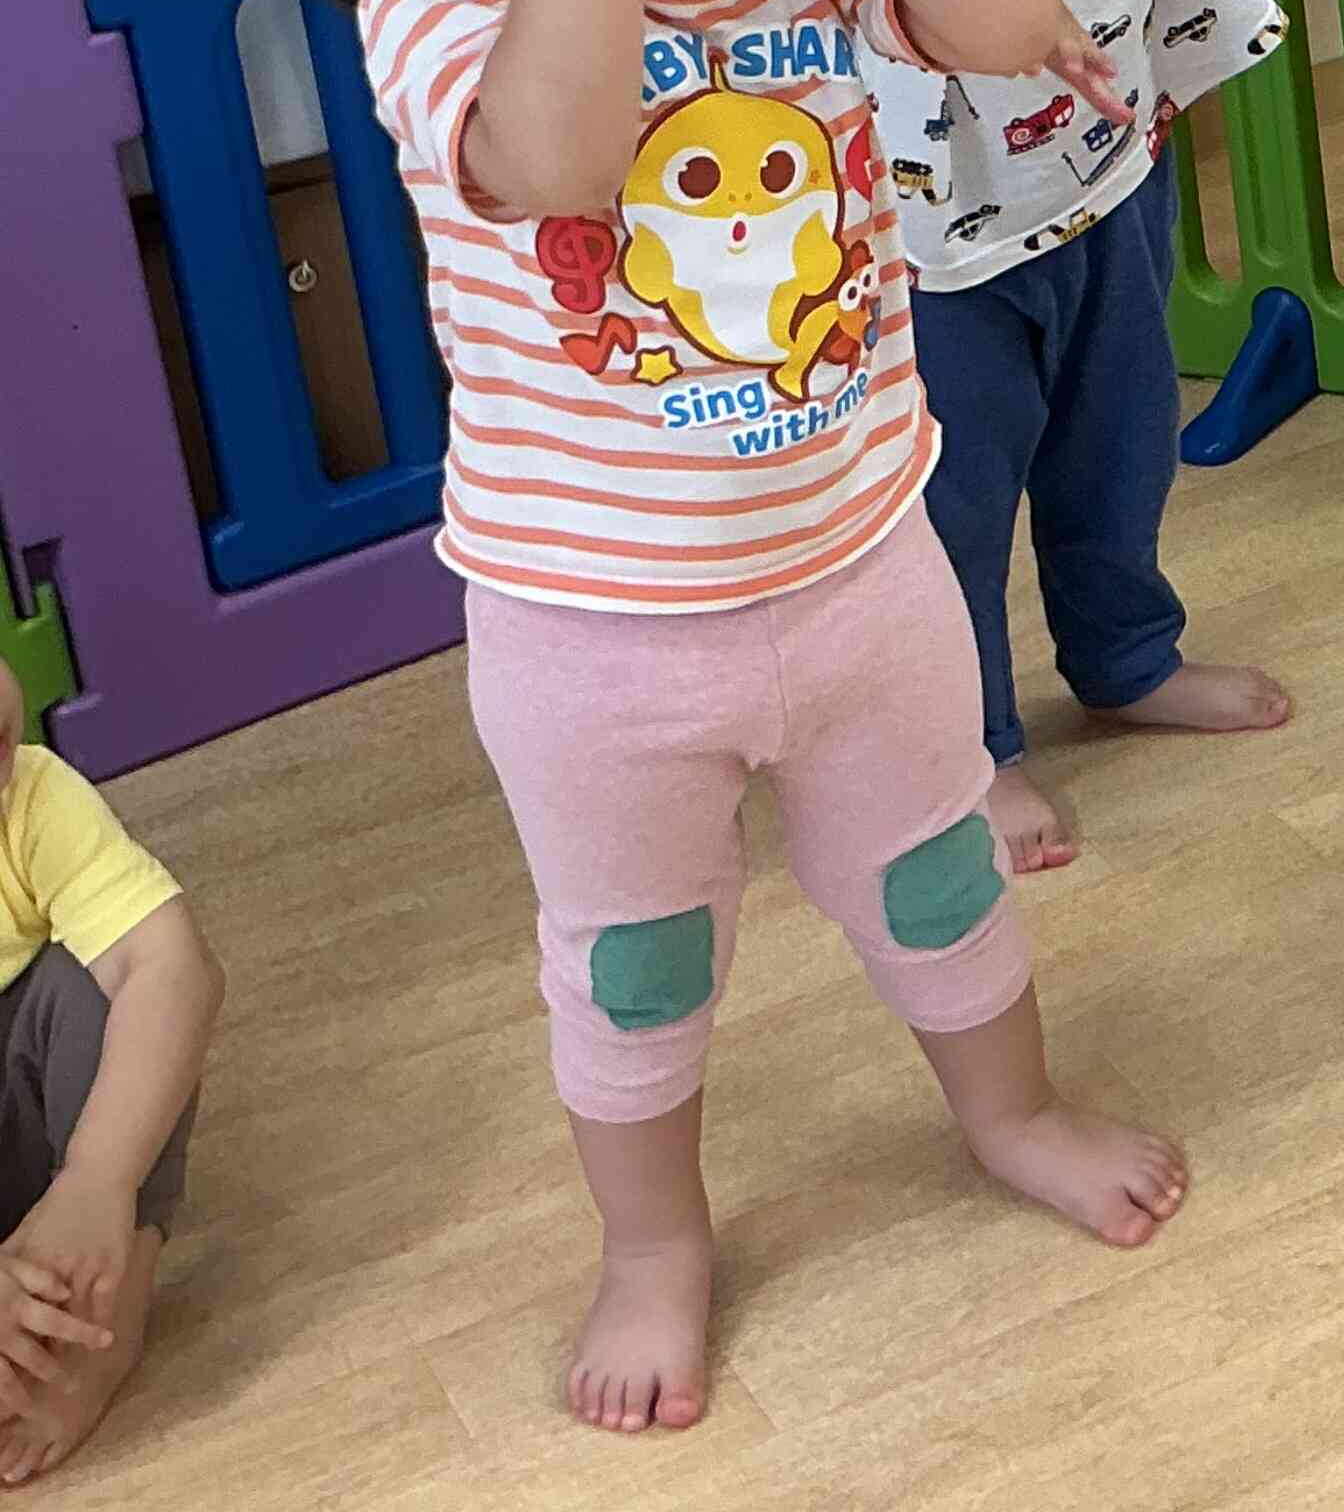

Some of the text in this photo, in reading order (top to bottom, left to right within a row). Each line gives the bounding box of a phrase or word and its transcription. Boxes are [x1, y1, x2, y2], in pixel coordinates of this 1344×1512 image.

[642, 31, 707, 102] BY
[663, 381, 766, 428] Sing
[733, 372, 868, 456] with me
